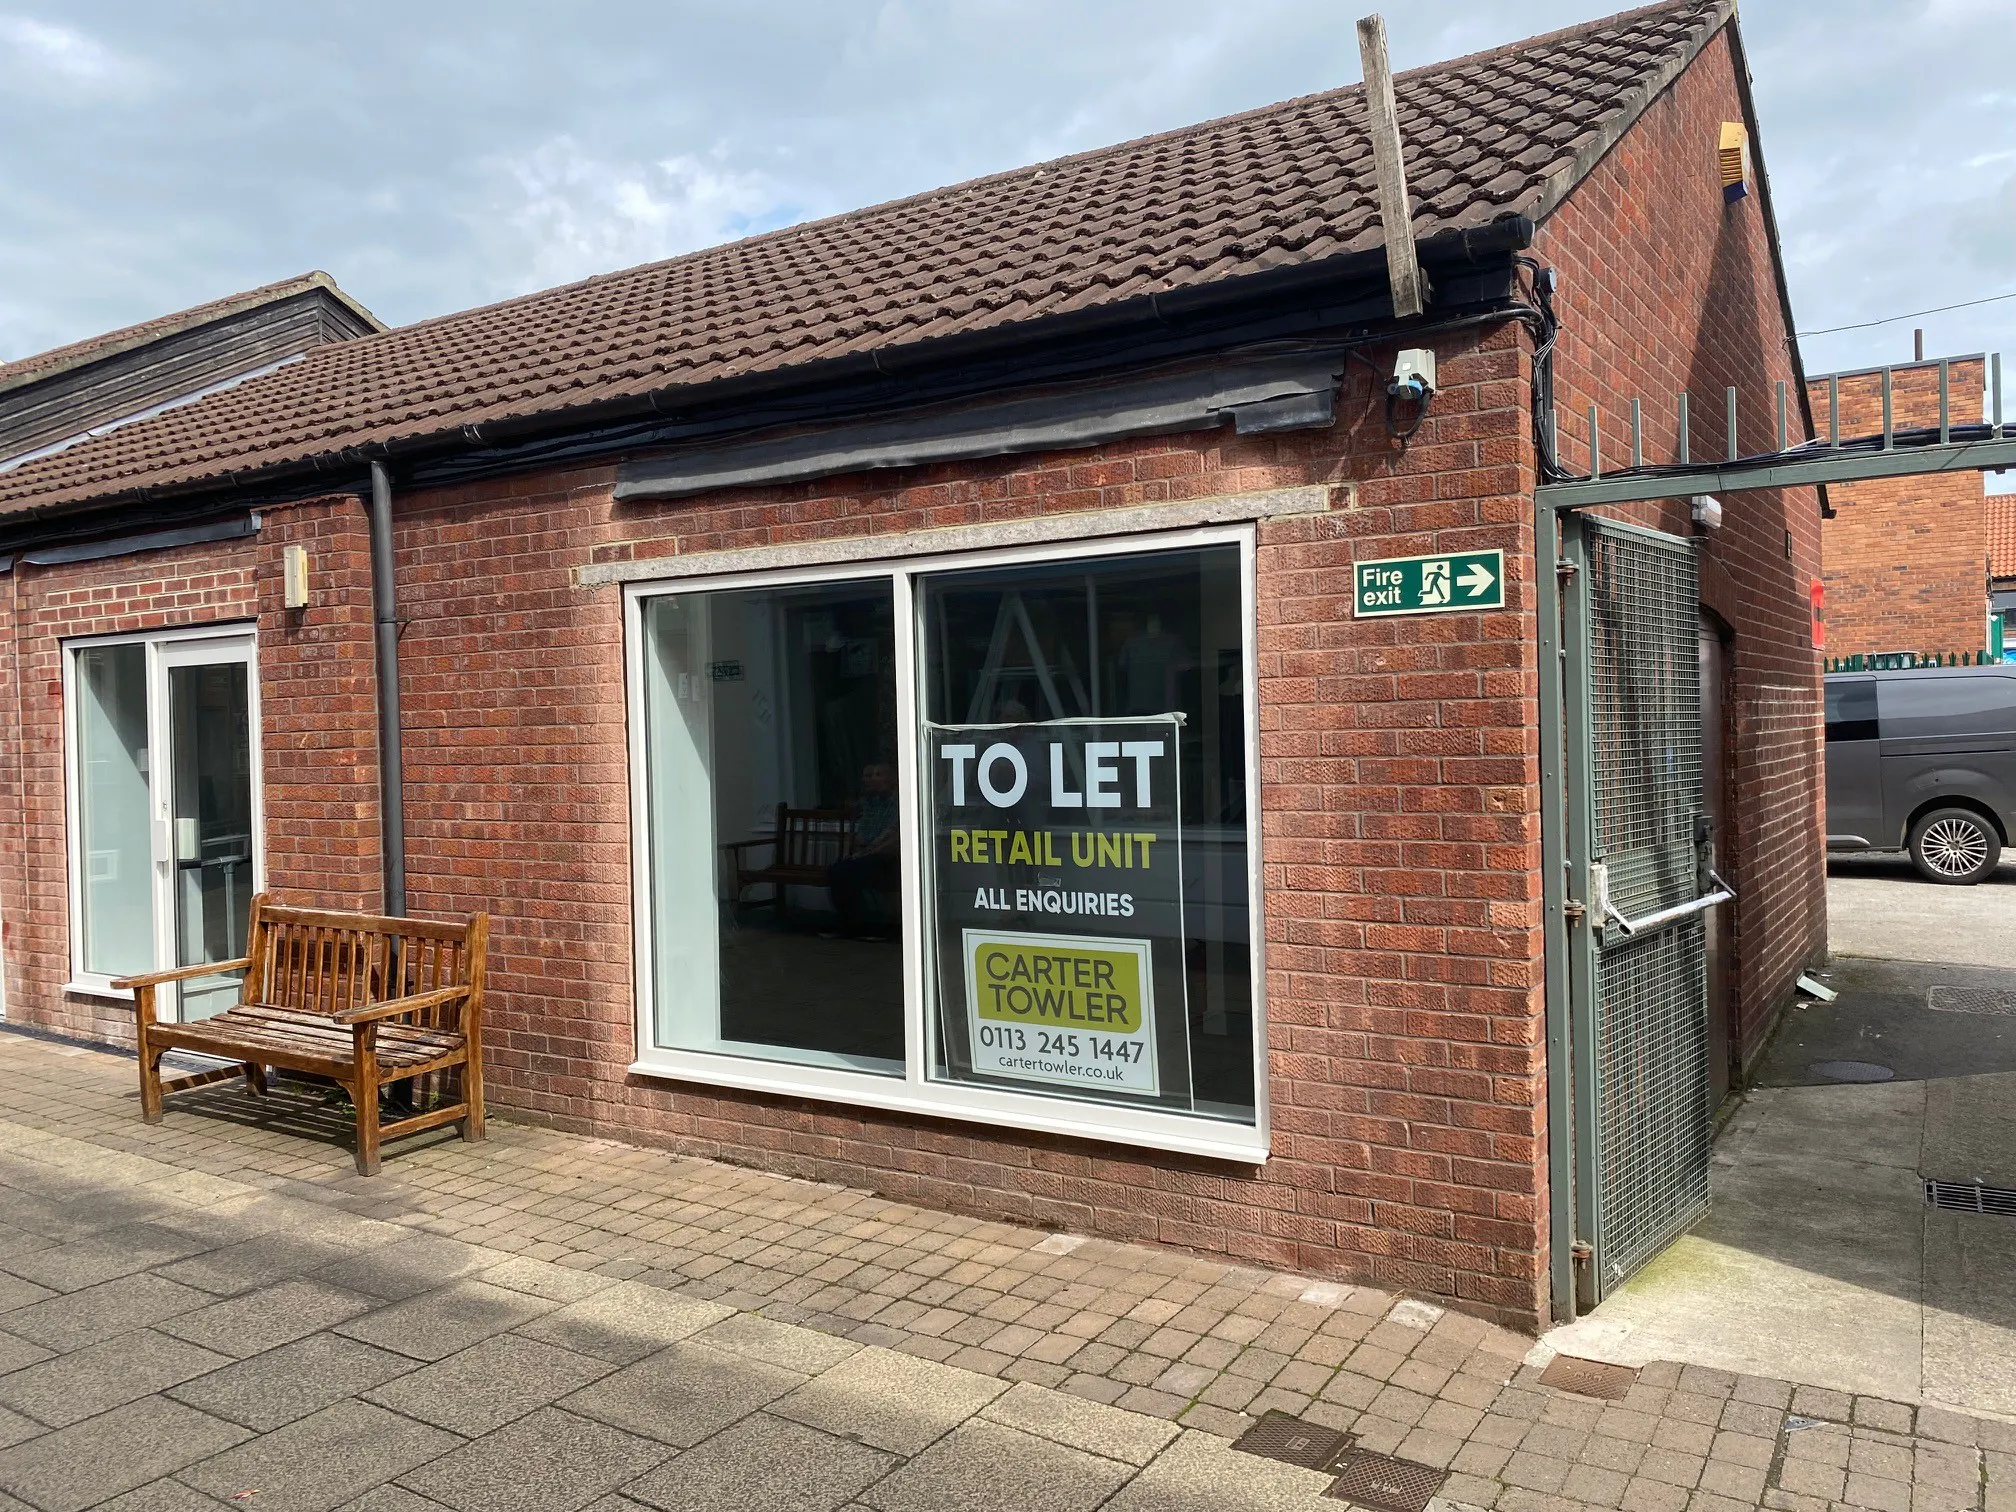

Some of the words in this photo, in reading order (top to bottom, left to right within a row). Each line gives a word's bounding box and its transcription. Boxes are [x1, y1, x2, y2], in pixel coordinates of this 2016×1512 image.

[1362, 568, 1403, 588] Fire
[1363, 586, 1402, 606] exit
[941, 742, 1028, 808] TO
[1050, 741, 1164, 808] LET
[950, 829, 1062, 867] RETAIL
[1071, 832, 1157, 869] UNIT
[974, 887, 1011, 911] ALL
[1016, 889, 1135, 917] ENQUIRIES
[985, 952, 1116, 990] CARTER
[988, 983, 1129, 1025] TOWLER
[980, 1025, 1027, 1051] 0113
[1037, 1031, 1080, 1057] 245
[1089, 1037, 1144, 1064] 1447
[998, 1056, 1124, 1081] cartertowler.co.uk
